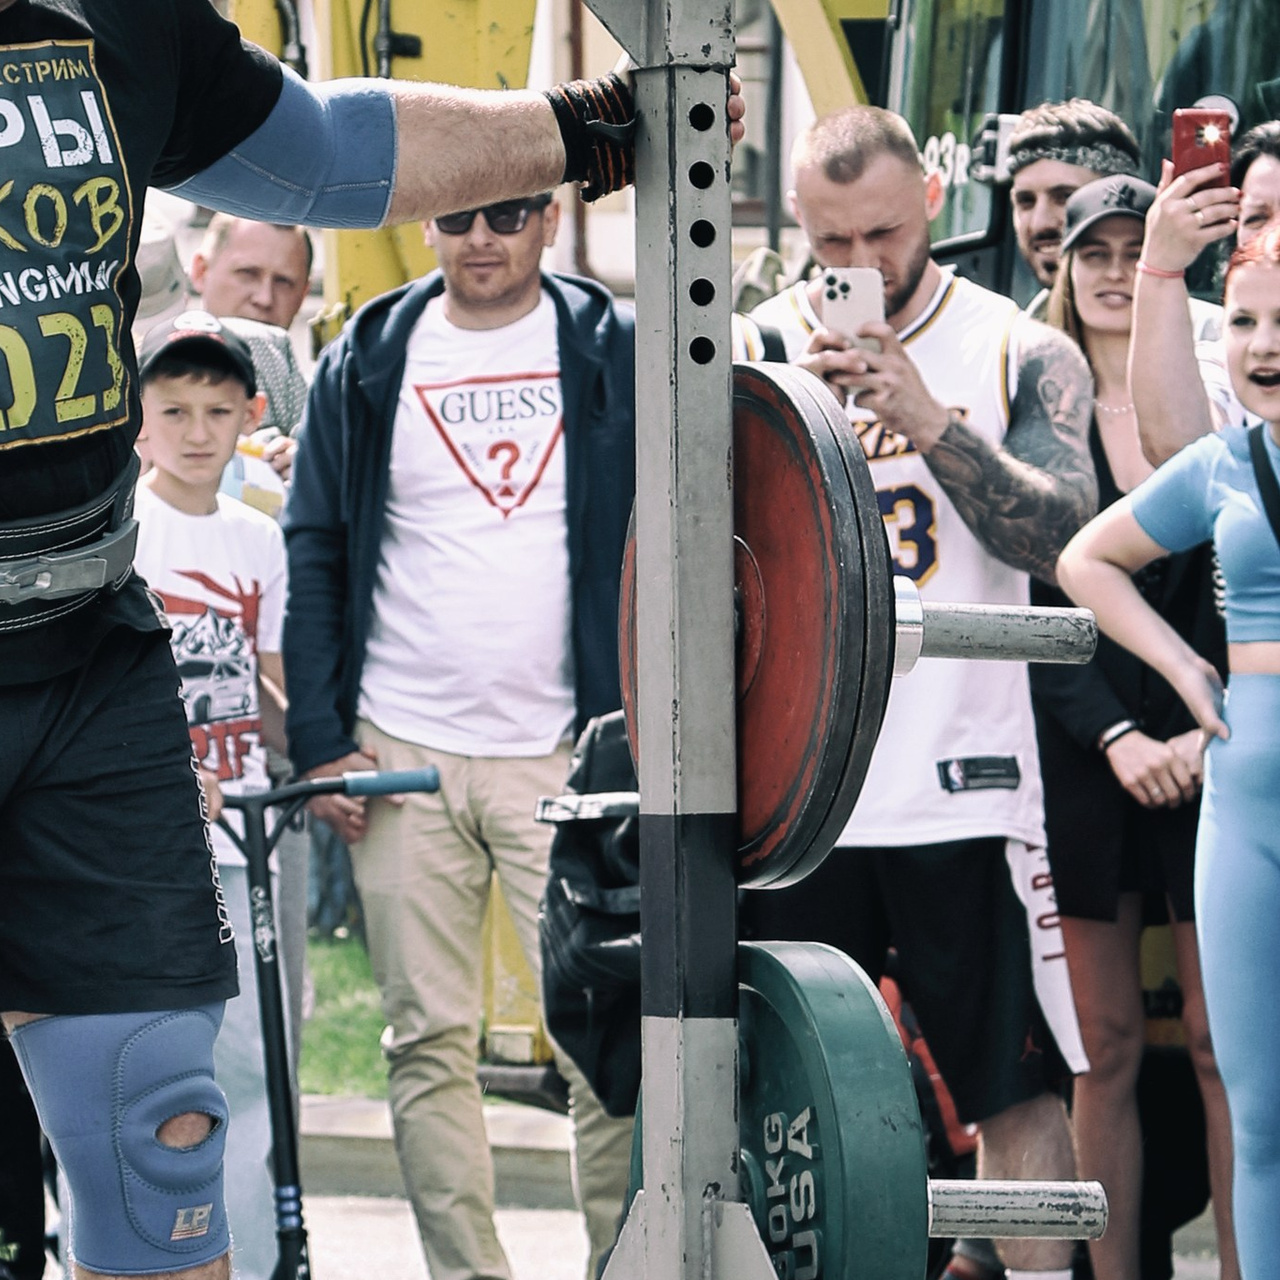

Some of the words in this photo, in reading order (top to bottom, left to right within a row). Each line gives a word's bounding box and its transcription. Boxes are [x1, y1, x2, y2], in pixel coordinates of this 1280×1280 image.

[918, 131, 971, 187] 93R
[440, 386, 558, 424] GUESS
[786, 1106, 819, 1280] USA
[172, 1204, 212, 1232] LP
